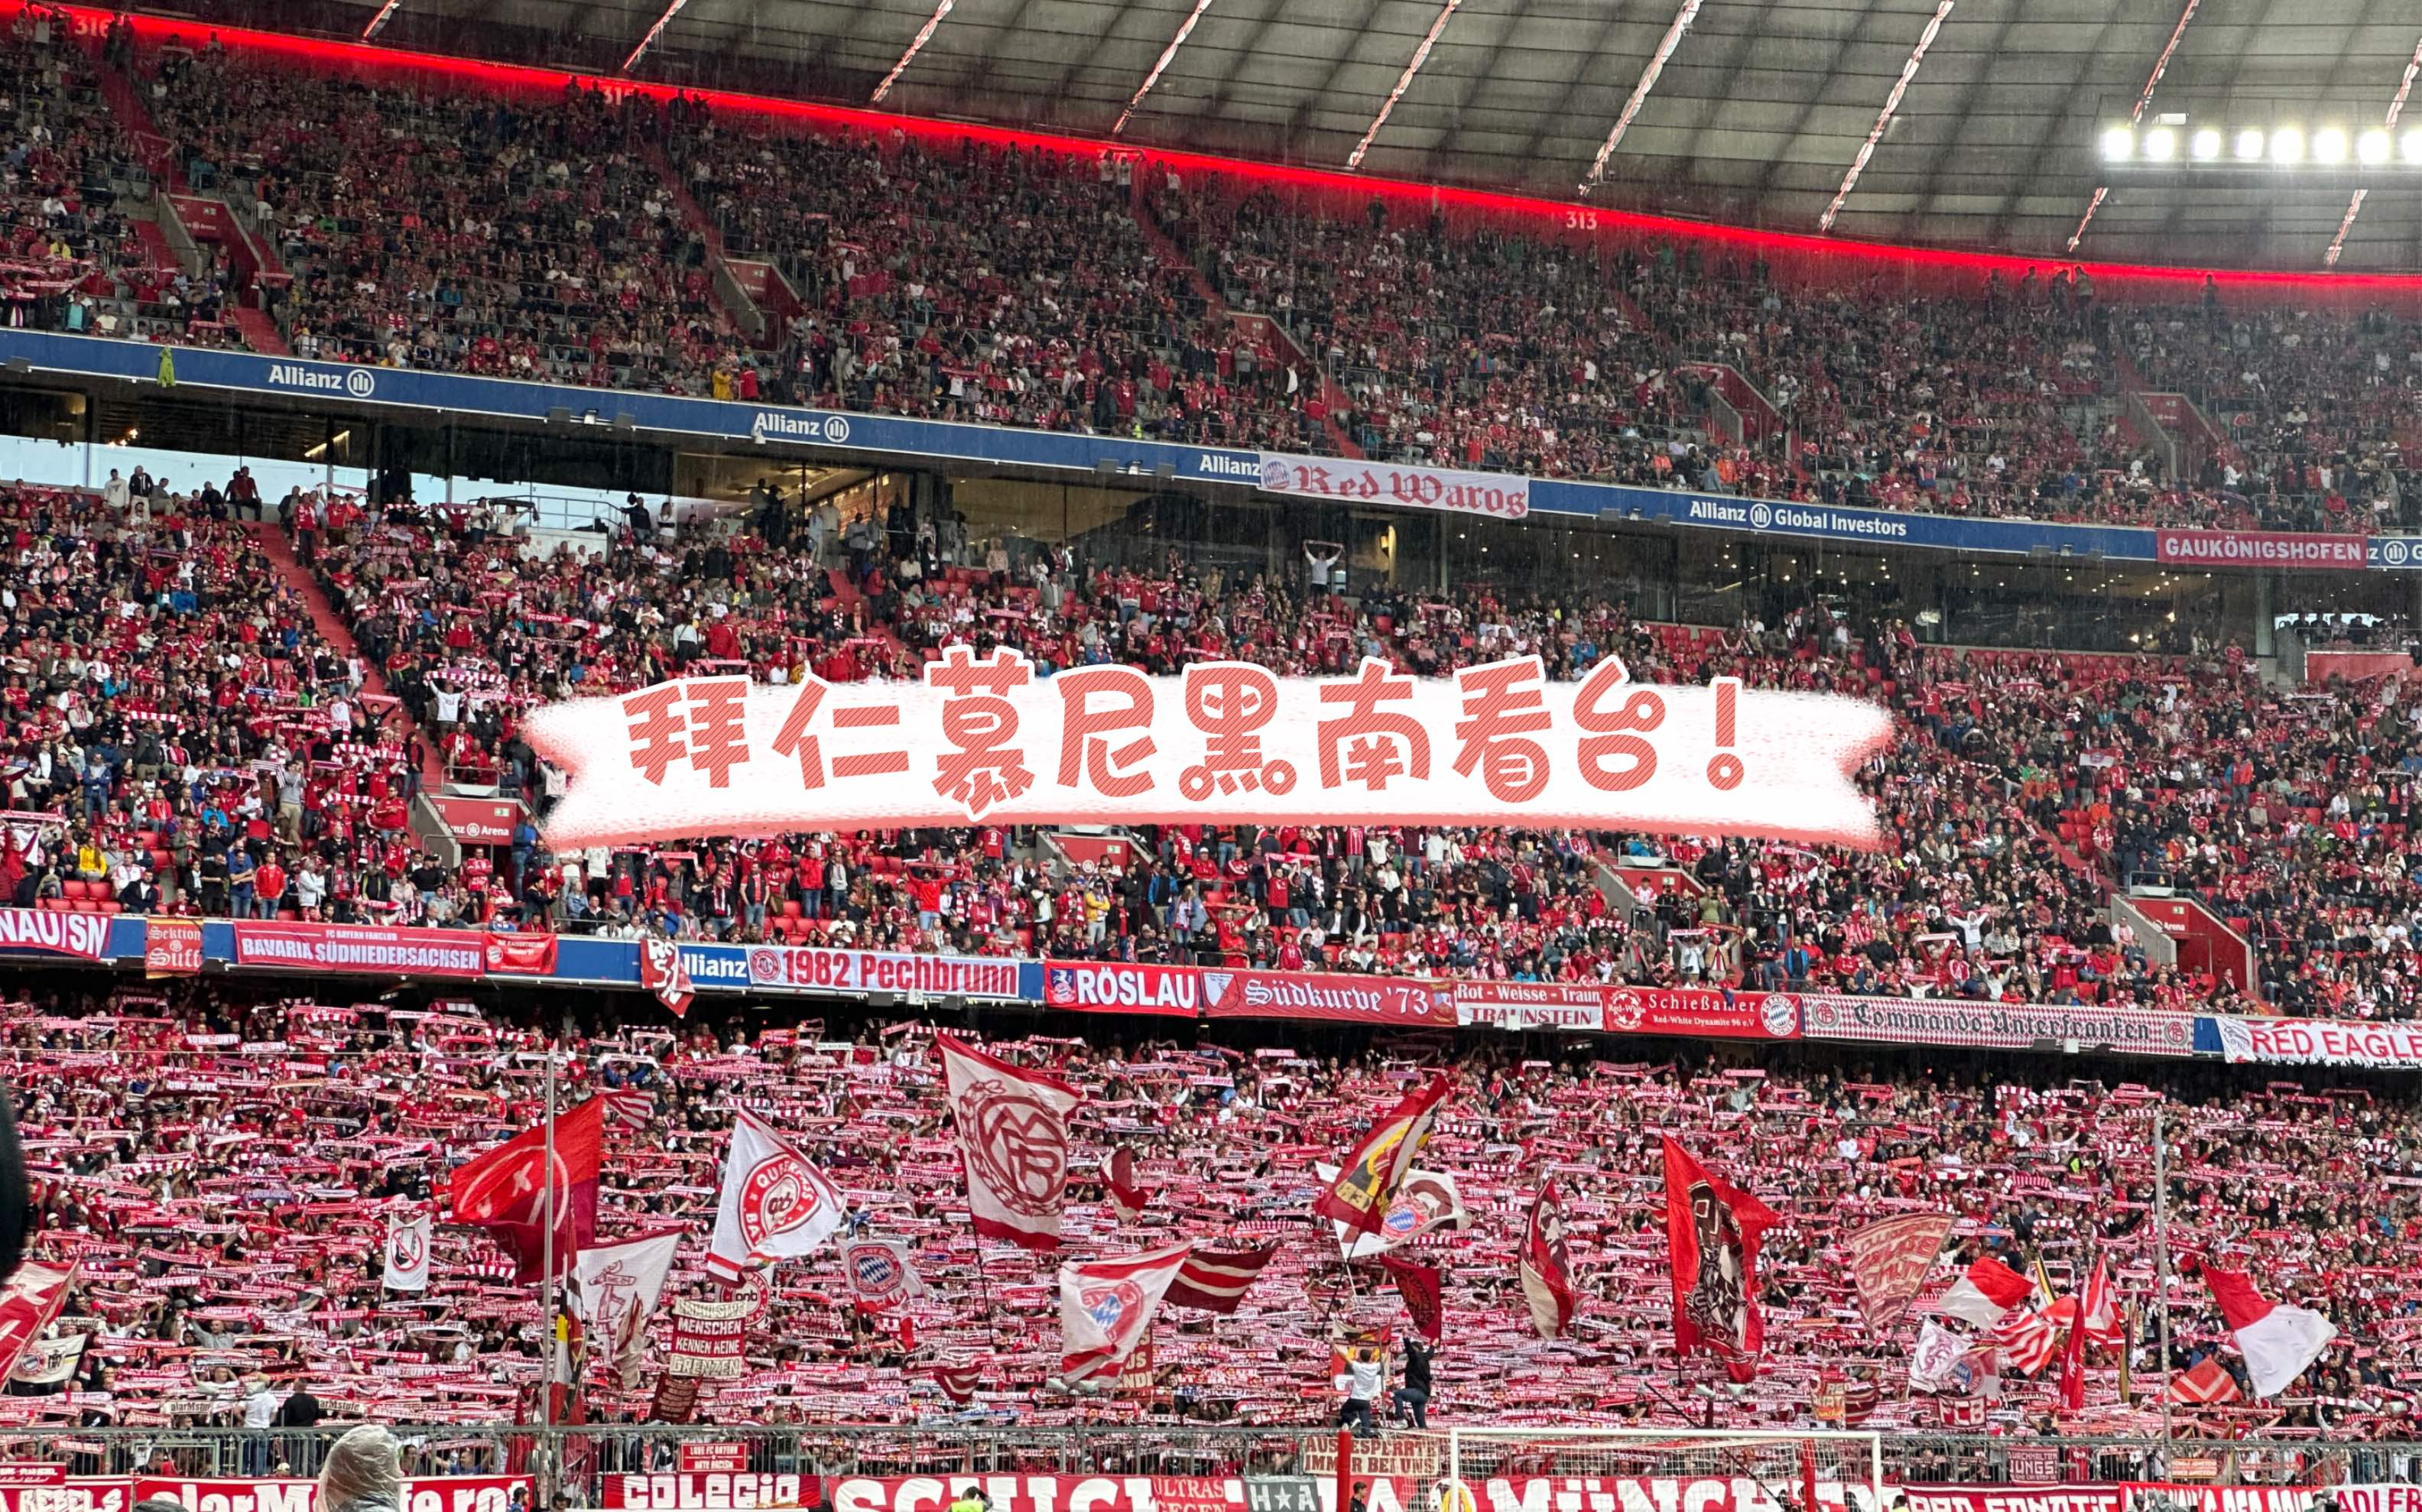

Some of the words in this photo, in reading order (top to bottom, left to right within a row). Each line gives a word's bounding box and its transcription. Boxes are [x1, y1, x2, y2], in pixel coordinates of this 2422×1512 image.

[1566, 211, 1597, 231] 313
[268, 365, 342, 391] Allianz
[754, 411, 820, 436] Allianz
[1200, 453, 1261, 476] Allianz
[1294, 465, 1380, 499] Red
[1690, 500, 1747, 522] Allianz
[1774, 508, 1826, 530] Global
[1831, 511, 1907, 537] Investors
[2164, 533, 2362, 563] GAUKÖNIGSHOFEN
[482, 825, 510, 836] Arena
[148, 926, 201, 940] Sektion
[326, 930, 336, 938] FC
[336, 930, 363, 939] BAYERN
[365, 932, 398, 941] FANCLUB
[2164, 921, 2185, 932] Arena
[242, 938, 313, 960] BAVARIA
[316, 942, 480, 970] SÜDNIEDERSACHSEN
[680, 952, 747, 978] llianz
[784, 949, 851, 988] 1982
[861, 953, 1017, 994] Pechbrunn
[1076, 965, 1194, 1009] RÖSLAU
[1245, 978, 1382, 1013] Südkurve
[1457, 983, 1485, 1000] Rot
[1495, 985, 1547, 1001] Weisse
[1562, 988, 1600, 1003] Traun
[1472, 1007, 1592, 1026] TRANSTEIN
[1653, 1015, 1692, 1026] Red-White
[1693, 1017, 1729, 1028] Dynamite
[1854, 1004, 1982, 1033] Commando
[1990, 1007, 2150, 1041] Unterfranken
[2249, 1029, 2313, 1055] RED
[2321, 1030, 2422, 1059] EAGLE
[677, 1319, 742, 1335] MENSCHEN
[675, 1338, 712, 1354] KENNEN
[713, 1339, 740, 1355] KEINE
[672, 1356, 741, 1377] GRENZEN
[690, 1445, 704, 1455] LOVE
[706, 1445, 714, 1455] FC
[715, 1445, 739, 1455] BAYERN
[1304, 1437, 1437, 1457] AUSESPERRTE
[694, 1461, 709, 1470] HATE
[710, 1460, 734, 1470] RACISM
[1304, 1454, 1363, 1473] IMMR
[2009, 1460, 2058, 1475] JUNGS!
[1151, 1478, 1226, 1500] ULTRAS
